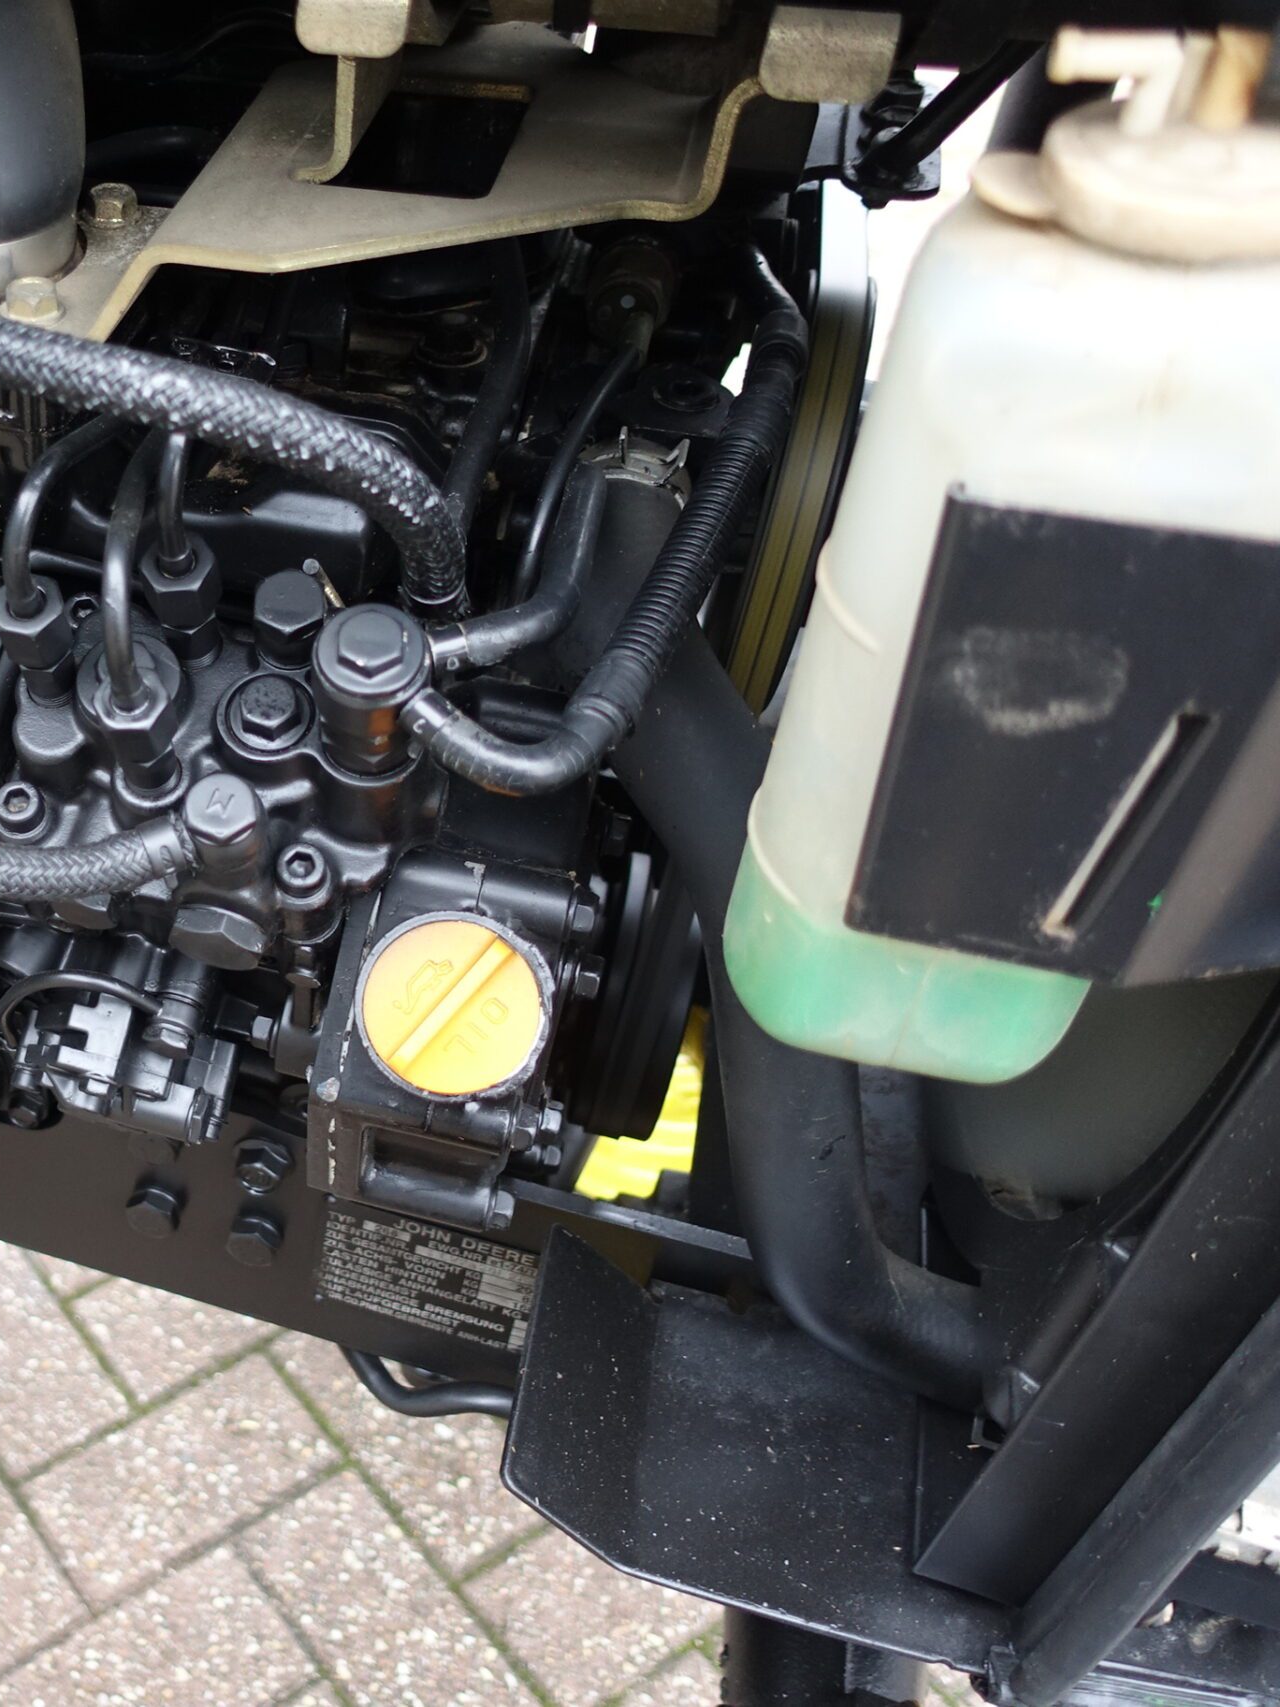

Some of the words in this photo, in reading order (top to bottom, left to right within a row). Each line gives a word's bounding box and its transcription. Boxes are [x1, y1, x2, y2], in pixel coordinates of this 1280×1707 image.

[442, 996, 510, 1055] OIL
[327, 1210, 356, 1224] TYP
[393, 1219, 451, 1244] JOHN
[461, 1237, 536, 1266] DEERE
[384, 1264, 438, 1287] HINTEN
[460, 1286, 478, 1298] KG
[404, 1260, 447, 1280] VORN
[463, 1278, 480, 1290] KG
[464, 1269, 481, 1281] KG
[424, 1303, 505, 1333] BREMSUNG
[502, 1308, 522, 1319] KG
